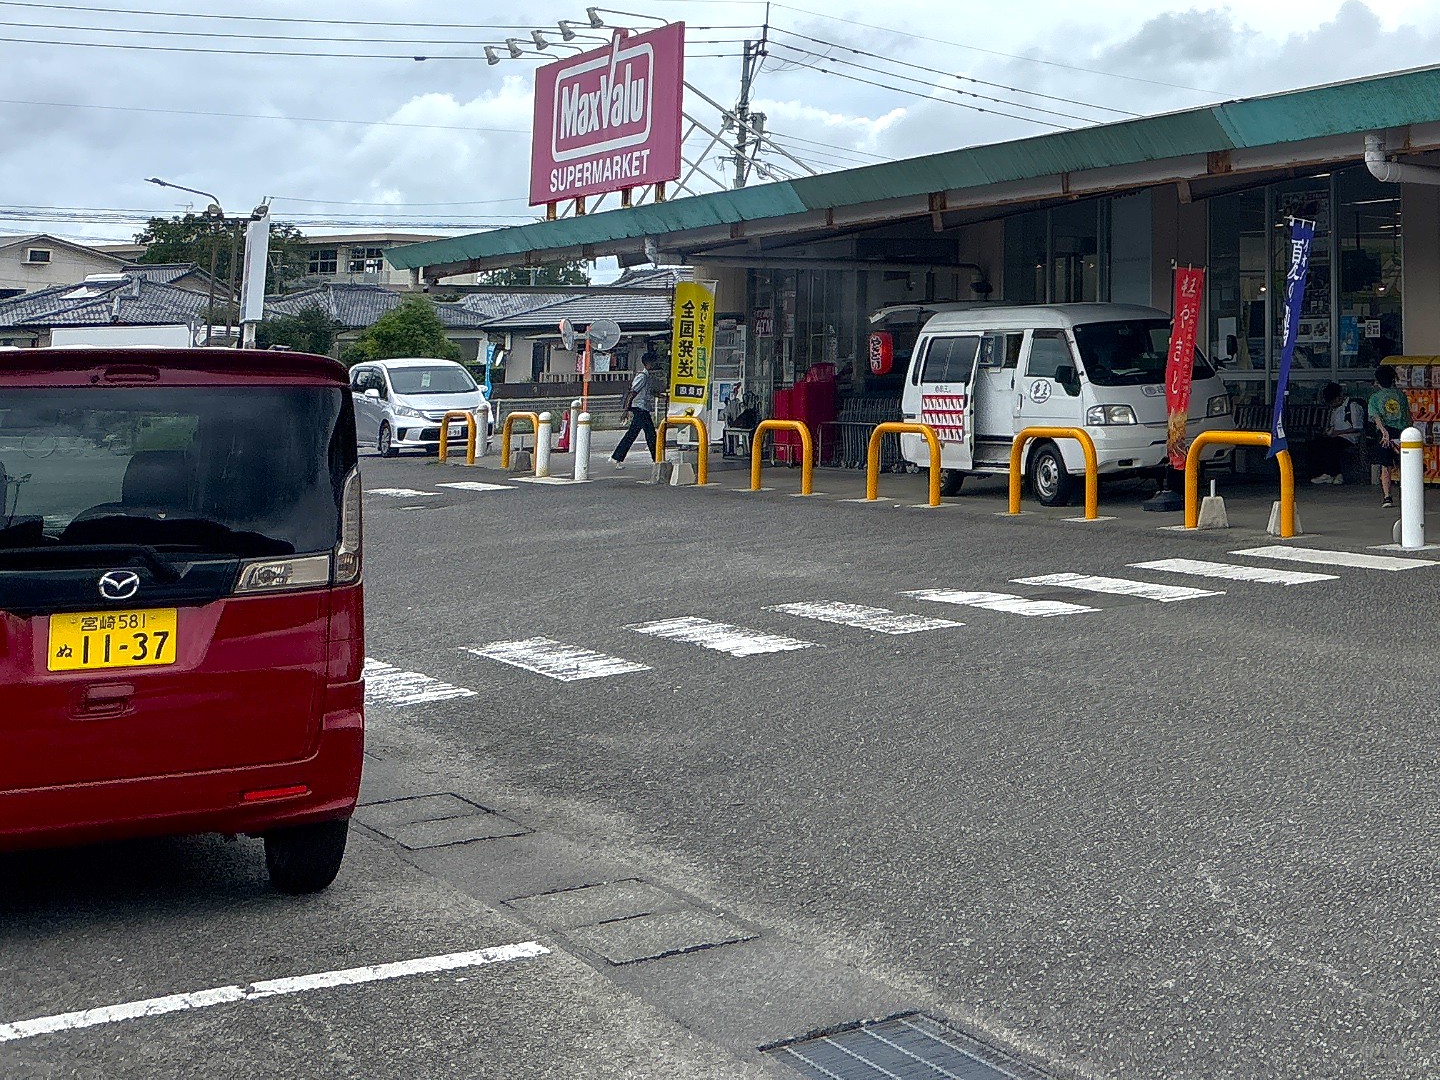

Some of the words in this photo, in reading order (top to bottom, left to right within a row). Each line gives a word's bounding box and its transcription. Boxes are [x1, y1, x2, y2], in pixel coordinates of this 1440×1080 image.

[559, 34, 645, 139] MaxValu
[550, 149, 650, 192] SUPERMARKET
[56, 644, 73, 658] ぬ
[82, 631, 169, 664] 11-37
